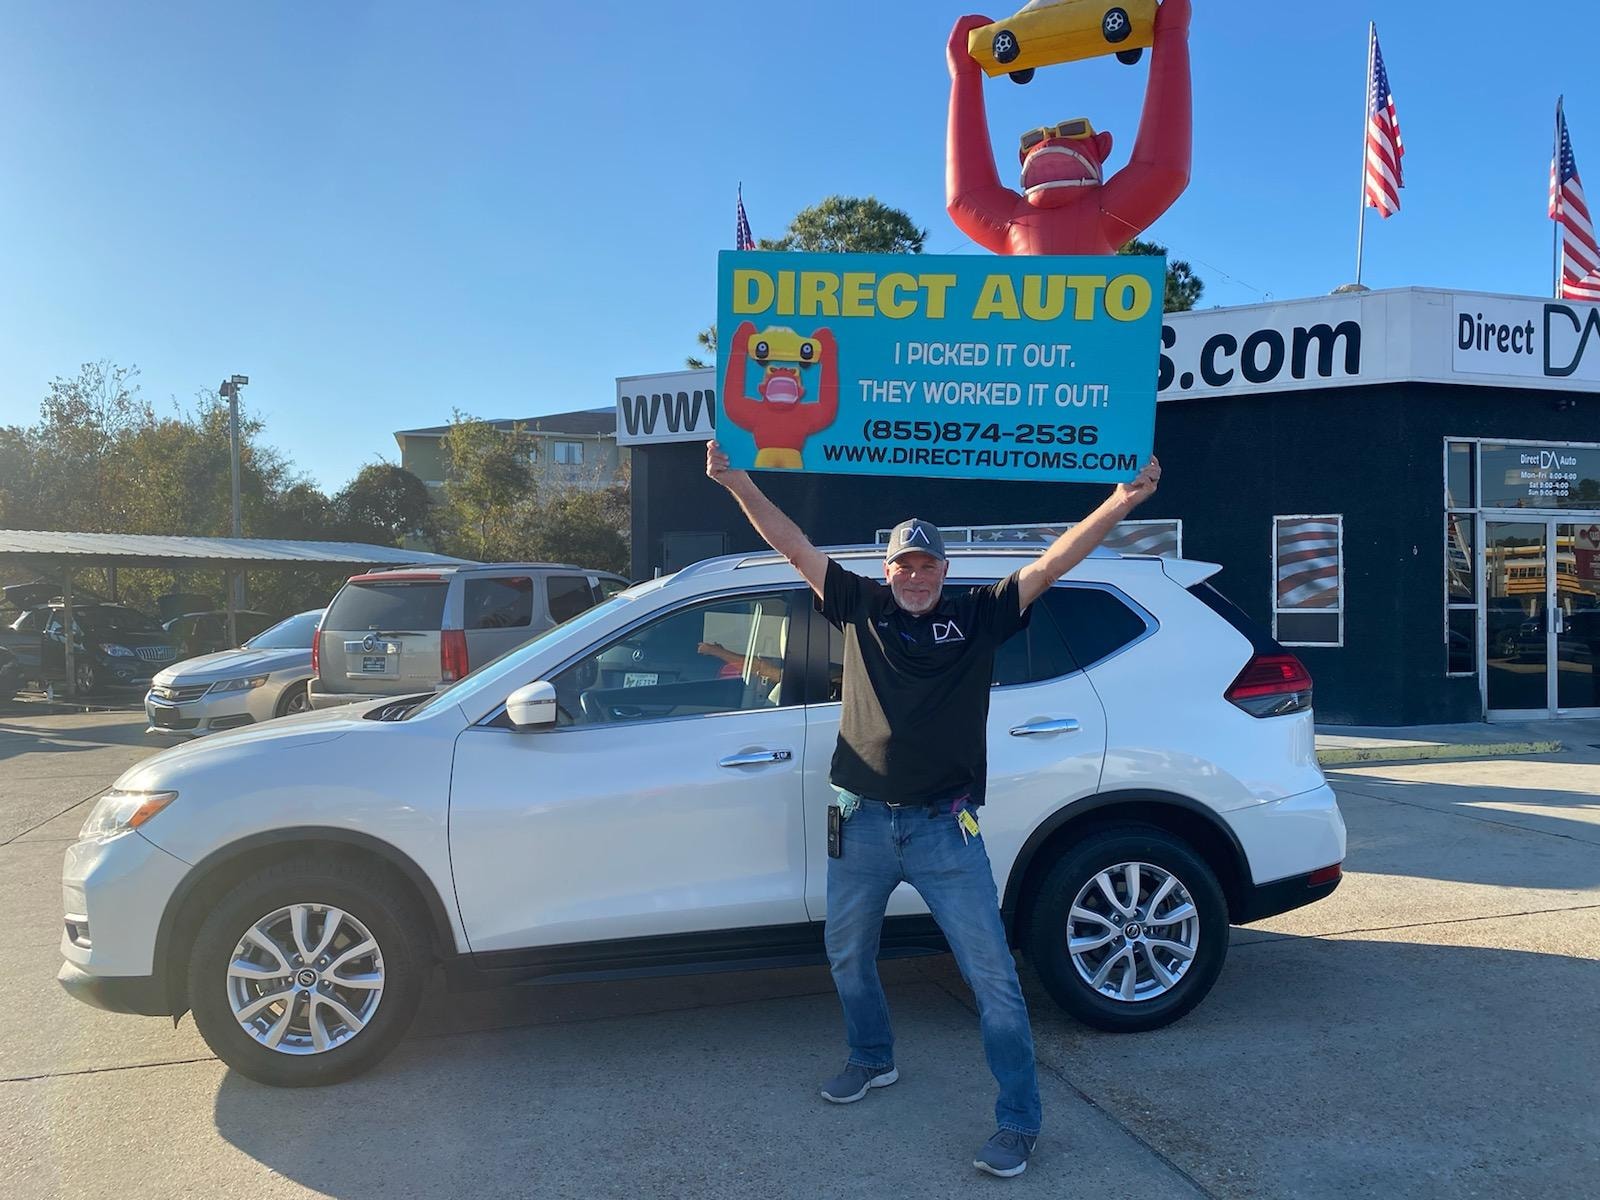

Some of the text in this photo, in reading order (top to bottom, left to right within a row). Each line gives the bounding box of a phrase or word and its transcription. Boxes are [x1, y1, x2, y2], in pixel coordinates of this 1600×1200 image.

[733, 269, 1153, 322] DIRECT AUTO
[1458, 312, 1535, 355] Direct
[895, 342, 1076, 368] I PICKED IT OUT.
[858, 380, 1110, 408] THEY WORKED IT OUT!
[863, 419, 1099, 445] (855)874-2536
[823, 444, 1138, 471] WWW.DIRECTAUTOMS.COM
[1520, 453, 1540, 465] Direct
[1560, 455, 1577, 466] Auto
[1520, 471, 1547, 479] Mon-Fri
[1529, 481, 1539, 489] Sat
[1528, 488, 1539, 497] Sun
